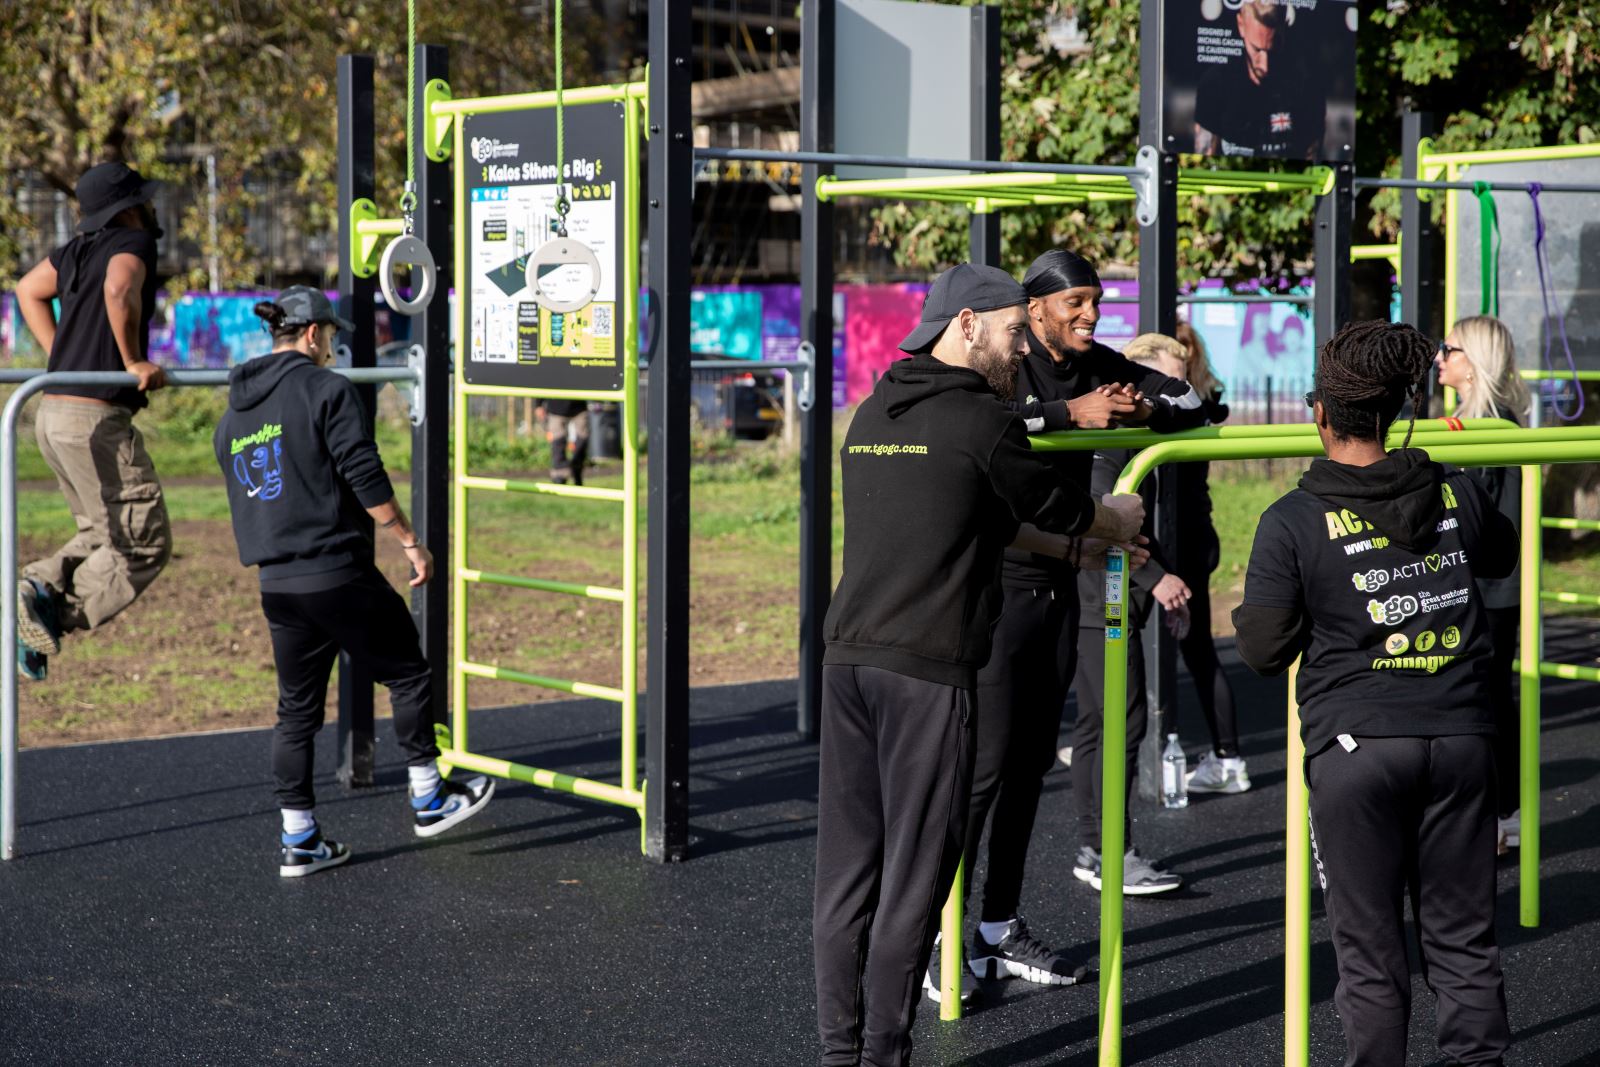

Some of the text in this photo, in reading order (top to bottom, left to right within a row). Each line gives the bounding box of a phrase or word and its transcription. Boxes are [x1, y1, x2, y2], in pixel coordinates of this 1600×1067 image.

[488, 158, 595, 182] Kalos Sthens Rig
[848, 444, 928, 455] www.tgogc.com
[1352, 569, 1390, 593] tgo
[1418, 590, 1431, 599] the
[1420, 588, 1469, 607] great outdoor
[1421, 595, 1469, 613] gym company
[1366, 594, 1418, 626] tgo
